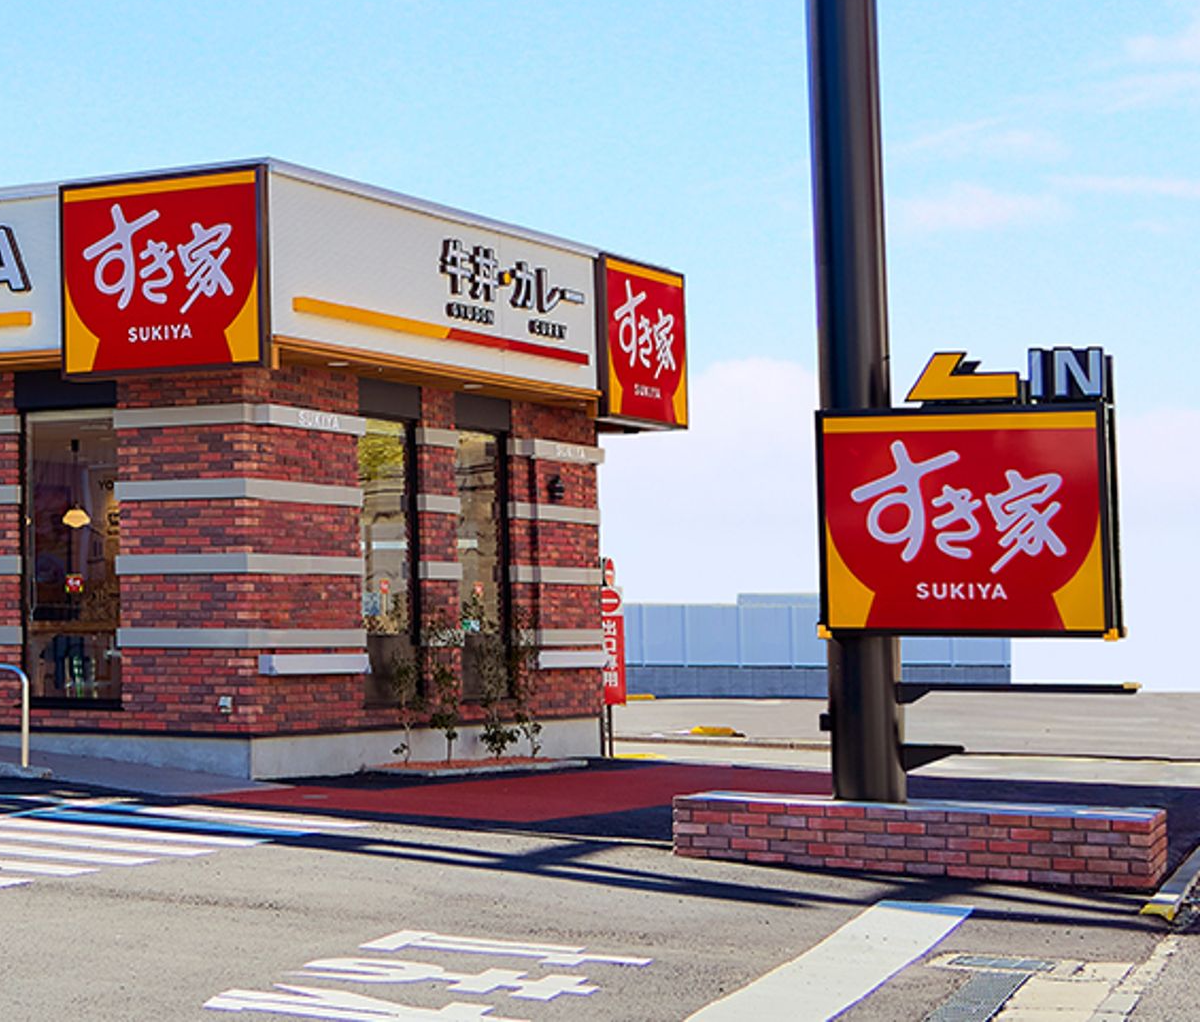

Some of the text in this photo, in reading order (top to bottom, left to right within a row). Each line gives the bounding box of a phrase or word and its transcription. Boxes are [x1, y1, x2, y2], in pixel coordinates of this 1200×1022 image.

[82, 203, 234, 314] すき家
[127, 323, 193, 343] SUKIYA
[613, 279, 676, 379] すき家
[1027, 347, 1104, 398] IN
[298, 410, 341, 430] SUKIYA
[850, 439, 1068, 574] すき家
[916, 582, 1008, 601] SUKIYA
